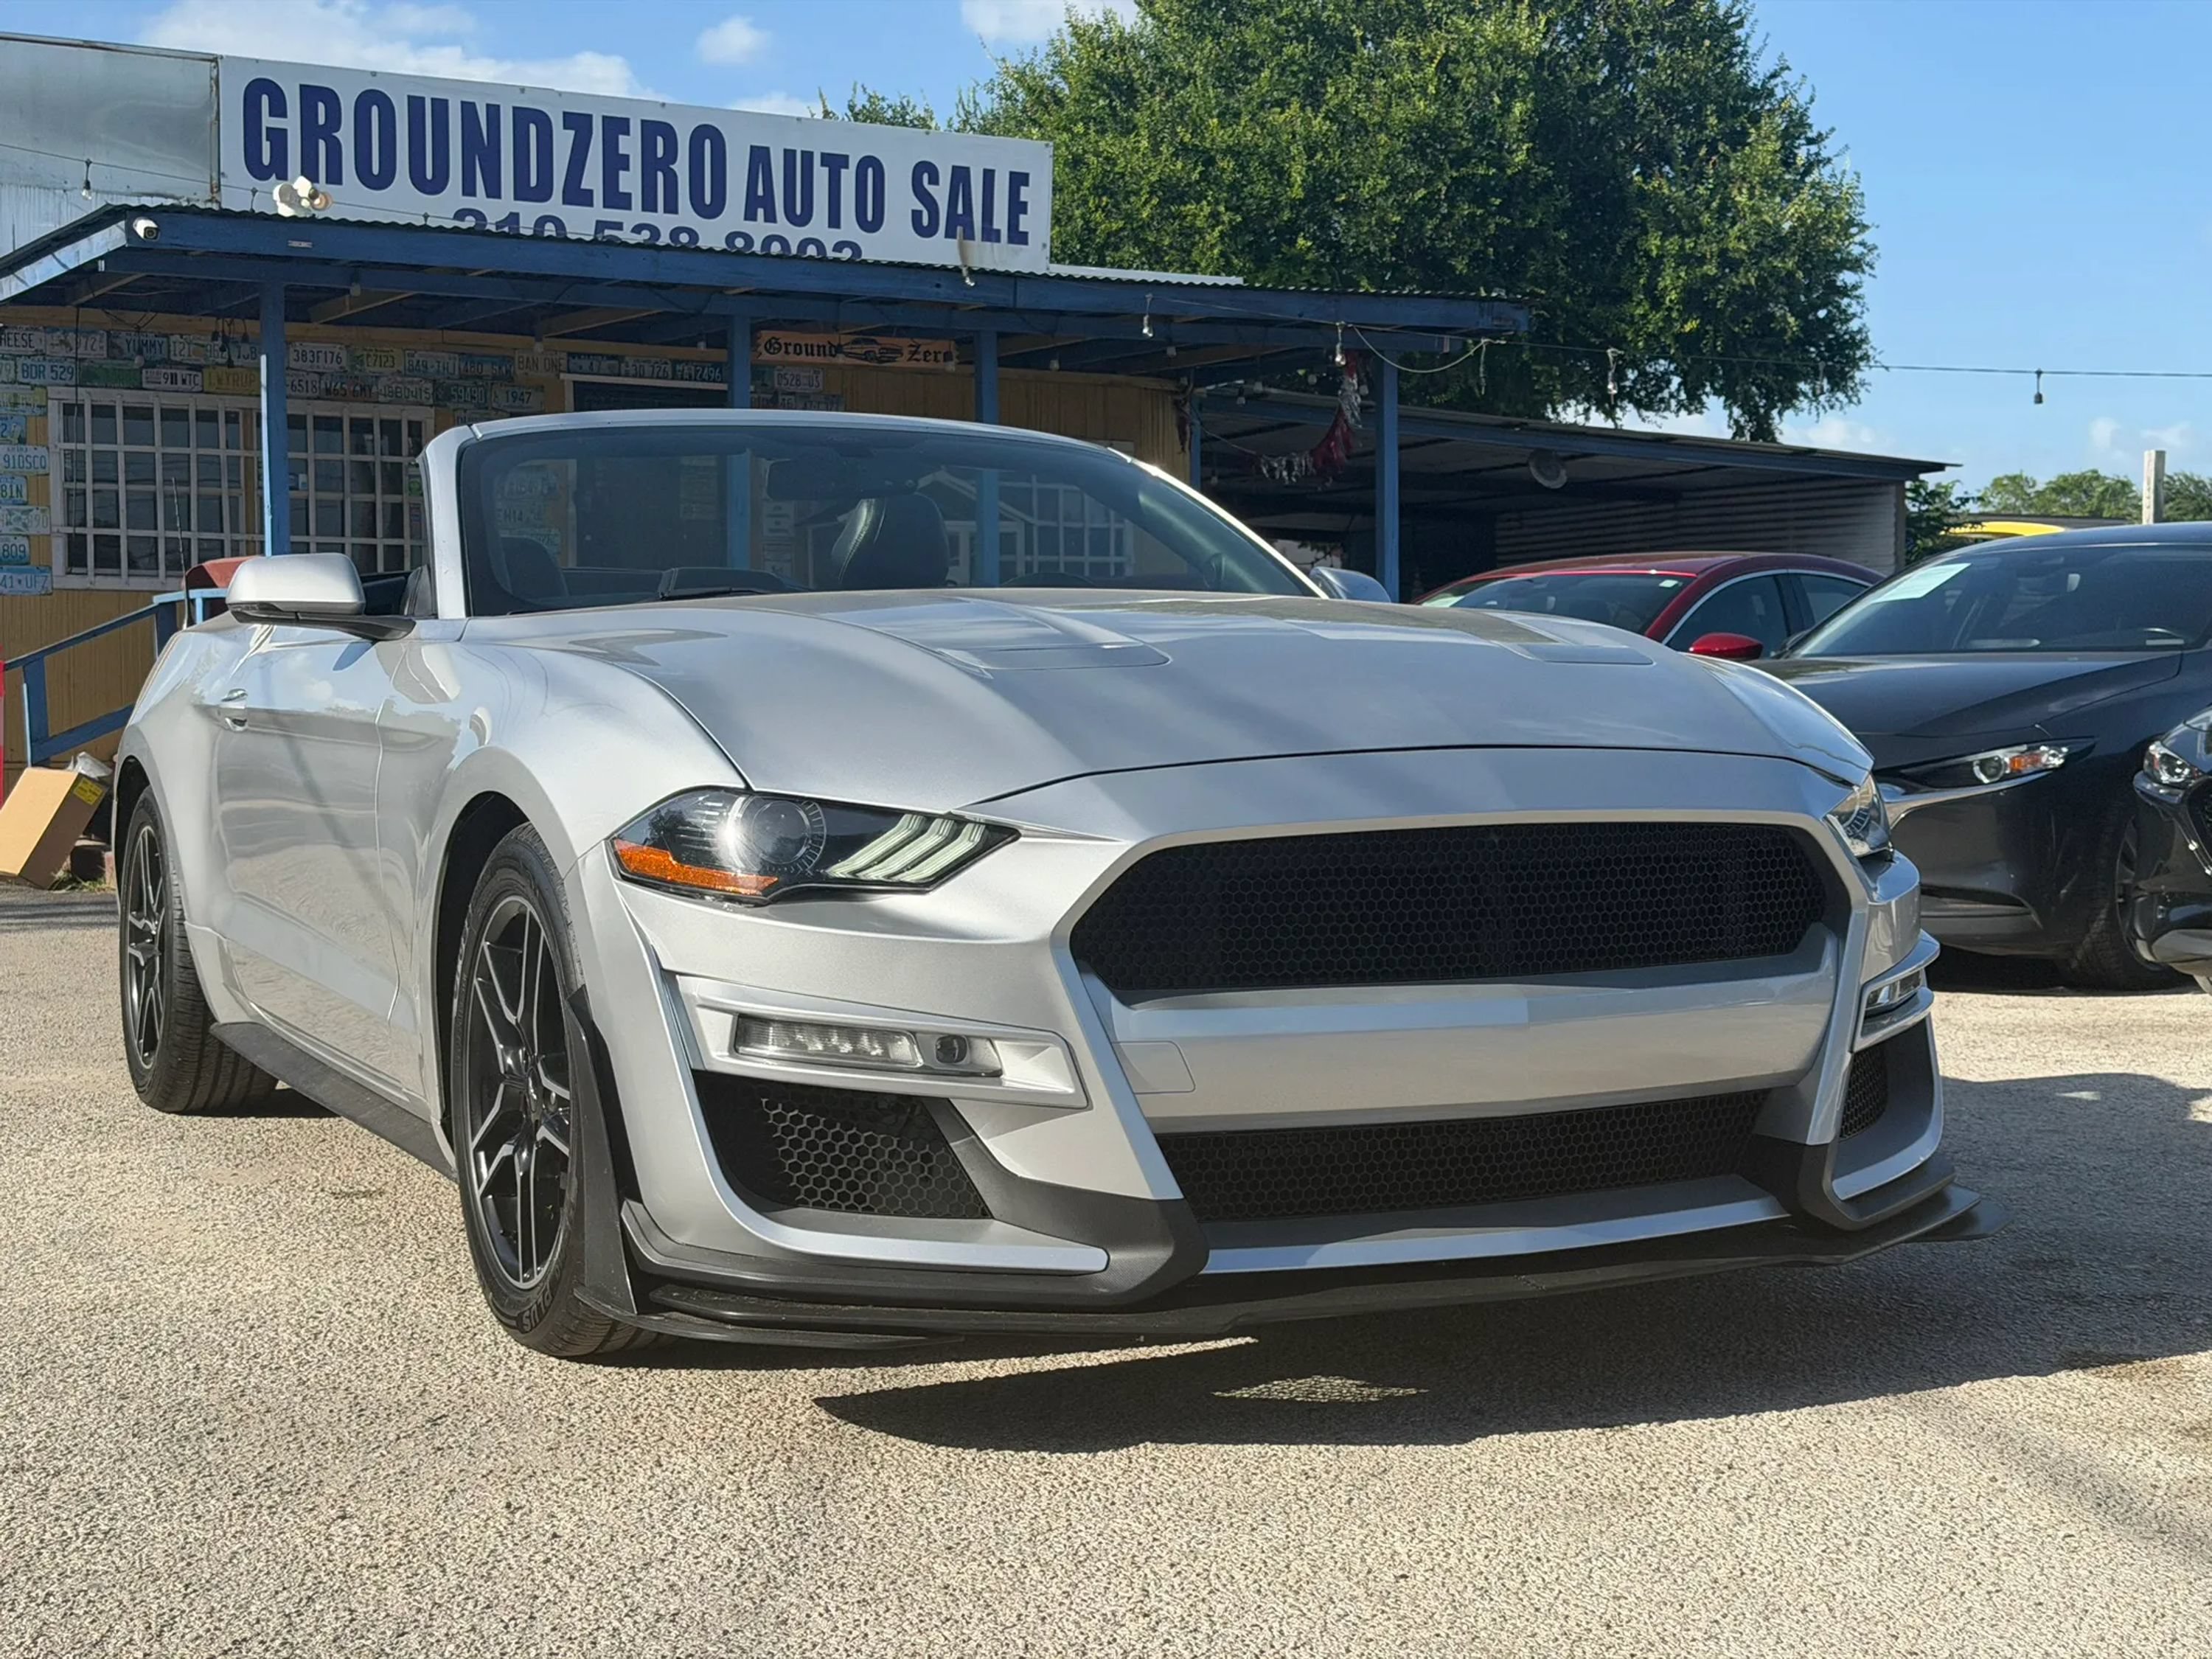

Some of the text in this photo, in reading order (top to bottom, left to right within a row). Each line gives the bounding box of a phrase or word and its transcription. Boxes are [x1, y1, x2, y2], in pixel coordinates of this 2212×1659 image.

[243, 77, 1030, 246] GROUNDZERO AUTO SALE
[125, 337, 164, 356] YUMMY
[764, 336, 838, 358] Ground
[50, 365, 74, 380] 529
